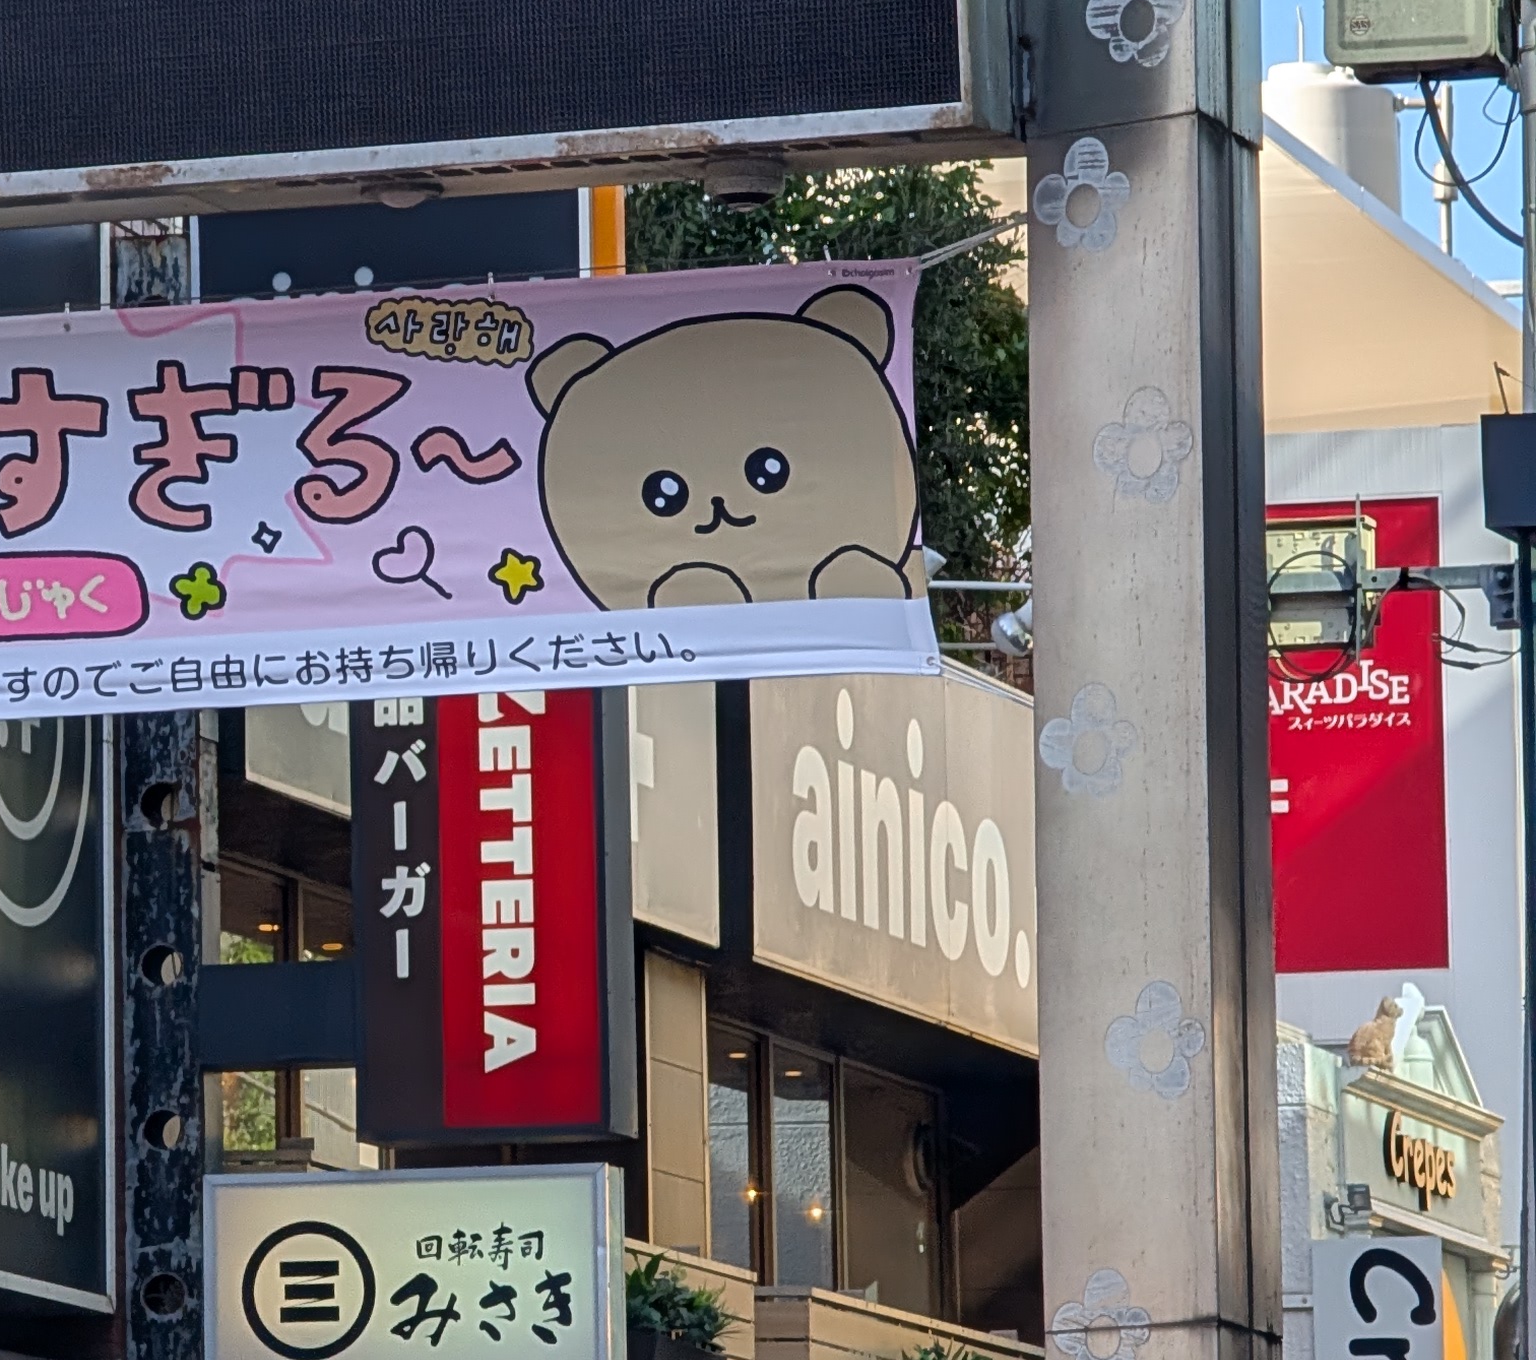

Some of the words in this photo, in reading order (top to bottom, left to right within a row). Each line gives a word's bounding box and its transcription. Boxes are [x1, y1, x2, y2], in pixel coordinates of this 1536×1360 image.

[373, 308, 523, 357] 사랑해
[1387, 1110, 1457, 1211] Crepes
[38, 1163, 75, 1237] up
[416, 1222, 545, 1271] 回転寿司
[389, 1269, 573, 1347] みさき
